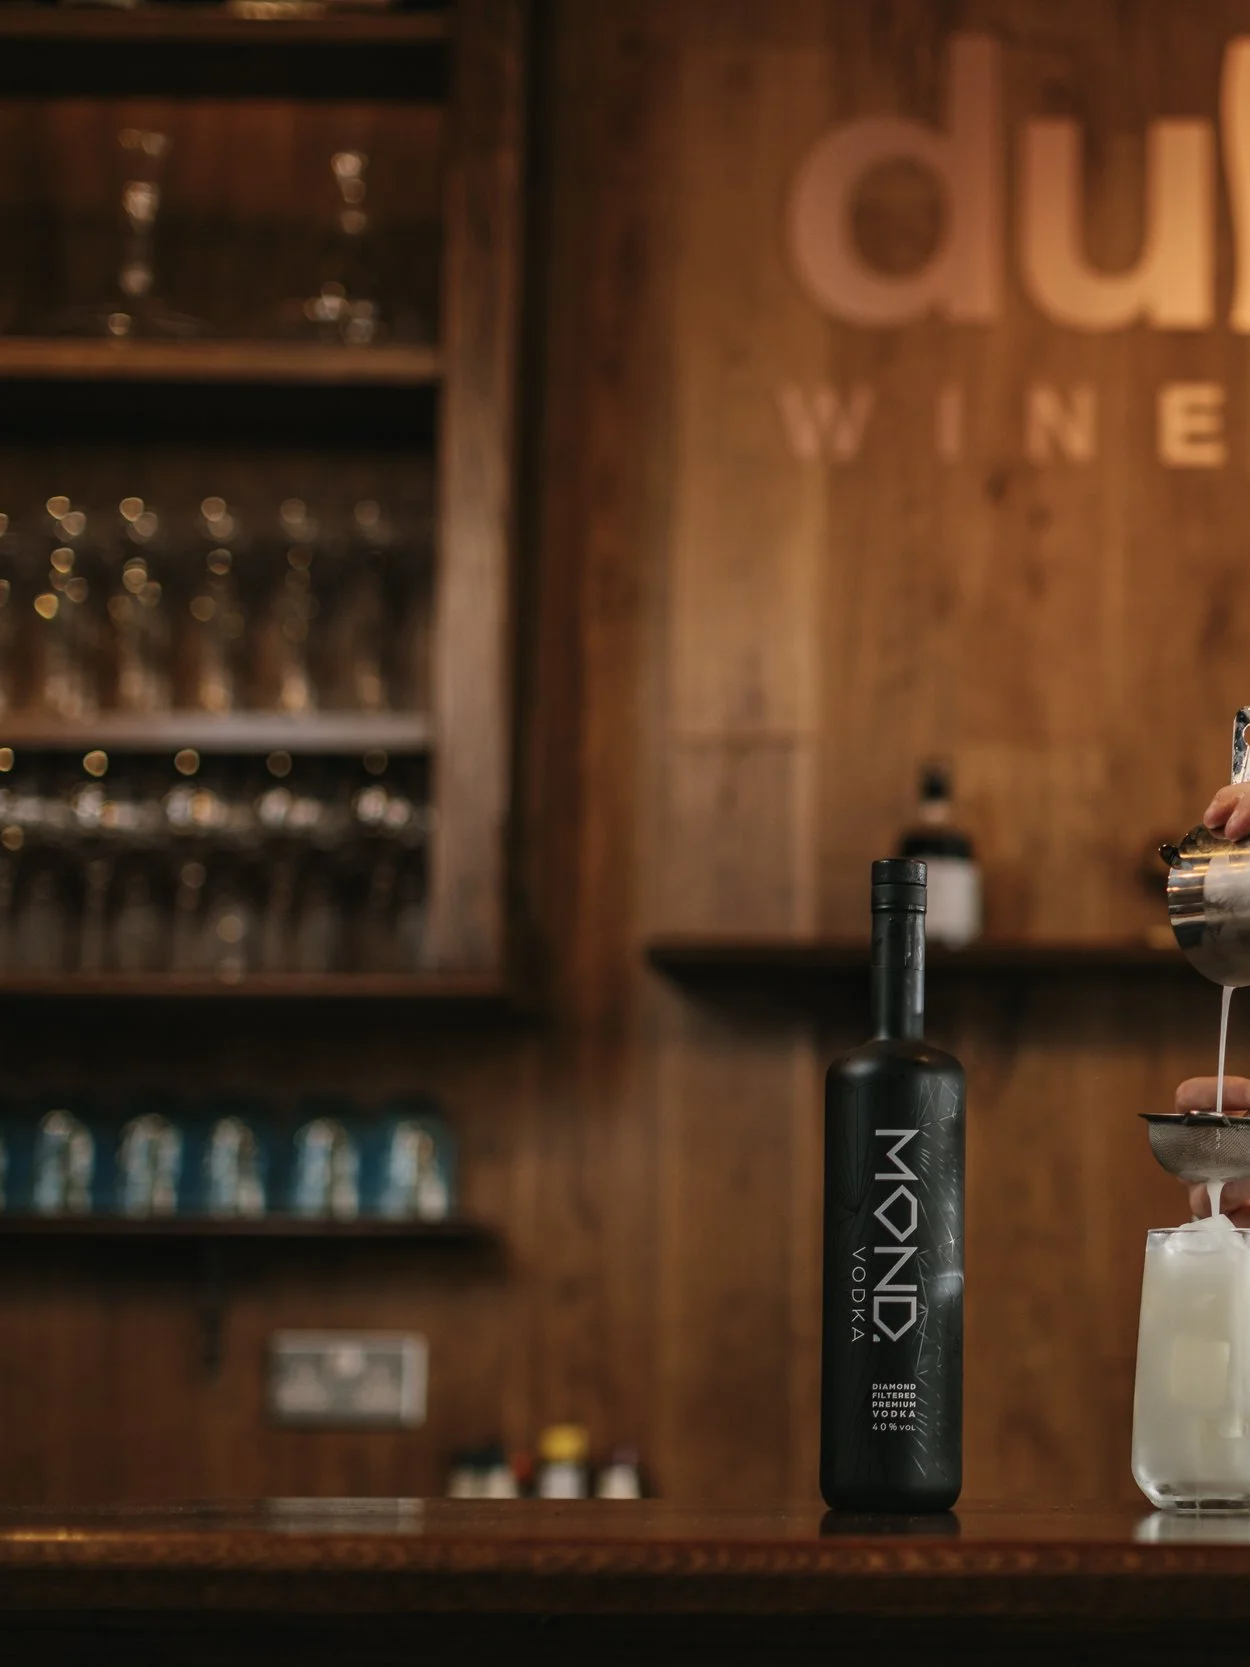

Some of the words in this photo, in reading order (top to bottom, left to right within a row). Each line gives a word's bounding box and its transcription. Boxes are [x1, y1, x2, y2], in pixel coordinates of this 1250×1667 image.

[780, 384, 1226, 467] WINE
[851, 1246, 866, 1342] VODKA
[872, 1410, 916, 1418] VODKA
